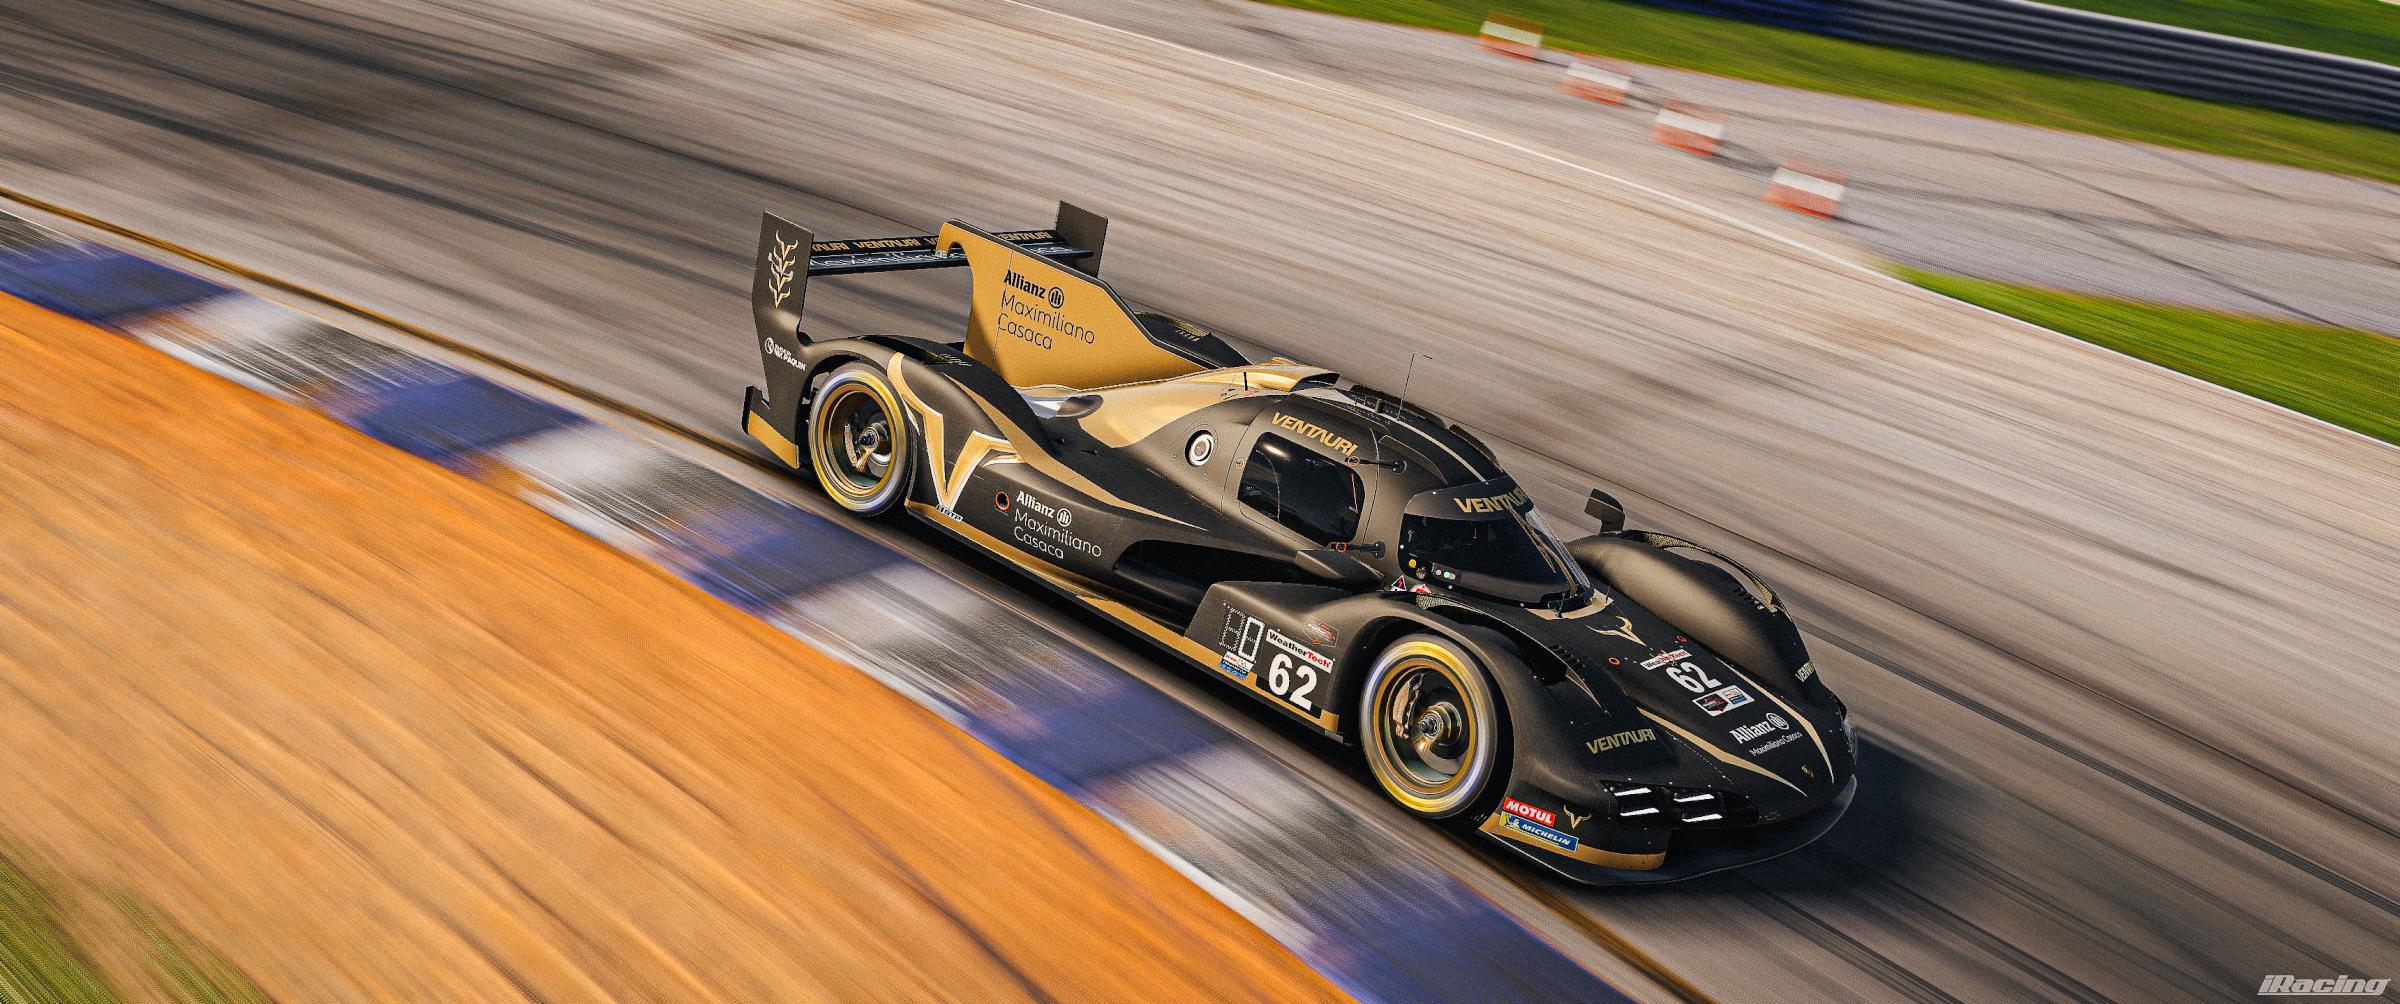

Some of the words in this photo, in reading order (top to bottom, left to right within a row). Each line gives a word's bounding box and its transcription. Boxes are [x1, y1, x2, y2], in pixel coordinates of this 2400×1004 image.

[853, 238, 921, 249] VENTAURI
[1003, 269, 1046, 299] Allianz
[998, 312, 1052, 350] Casaca
[1001, 290, 1095, 344] Maximiliano
[1271, 412, 1359, 456] VENTAURI
[1016, 491, 1056, 519] Allianz
[1014, 508, 1102, 557] Maximiliano
[1014, 526, 1064, 560] Casaca
[1268, 631, 1331, 669] WeatherTech
[1268, 653, 1318, 711] 62
[1666, 661, 1722, 693] 62
[1586, 728, 1657, 754] VENTAURI
[1729, 720, 1776, 744] Allianz
[1748, 738, 1786, 757] Maximiliano
[1505, 800, 1553, 825] MOTUL
[1521, 824, 1571, 846] MICHELIN
